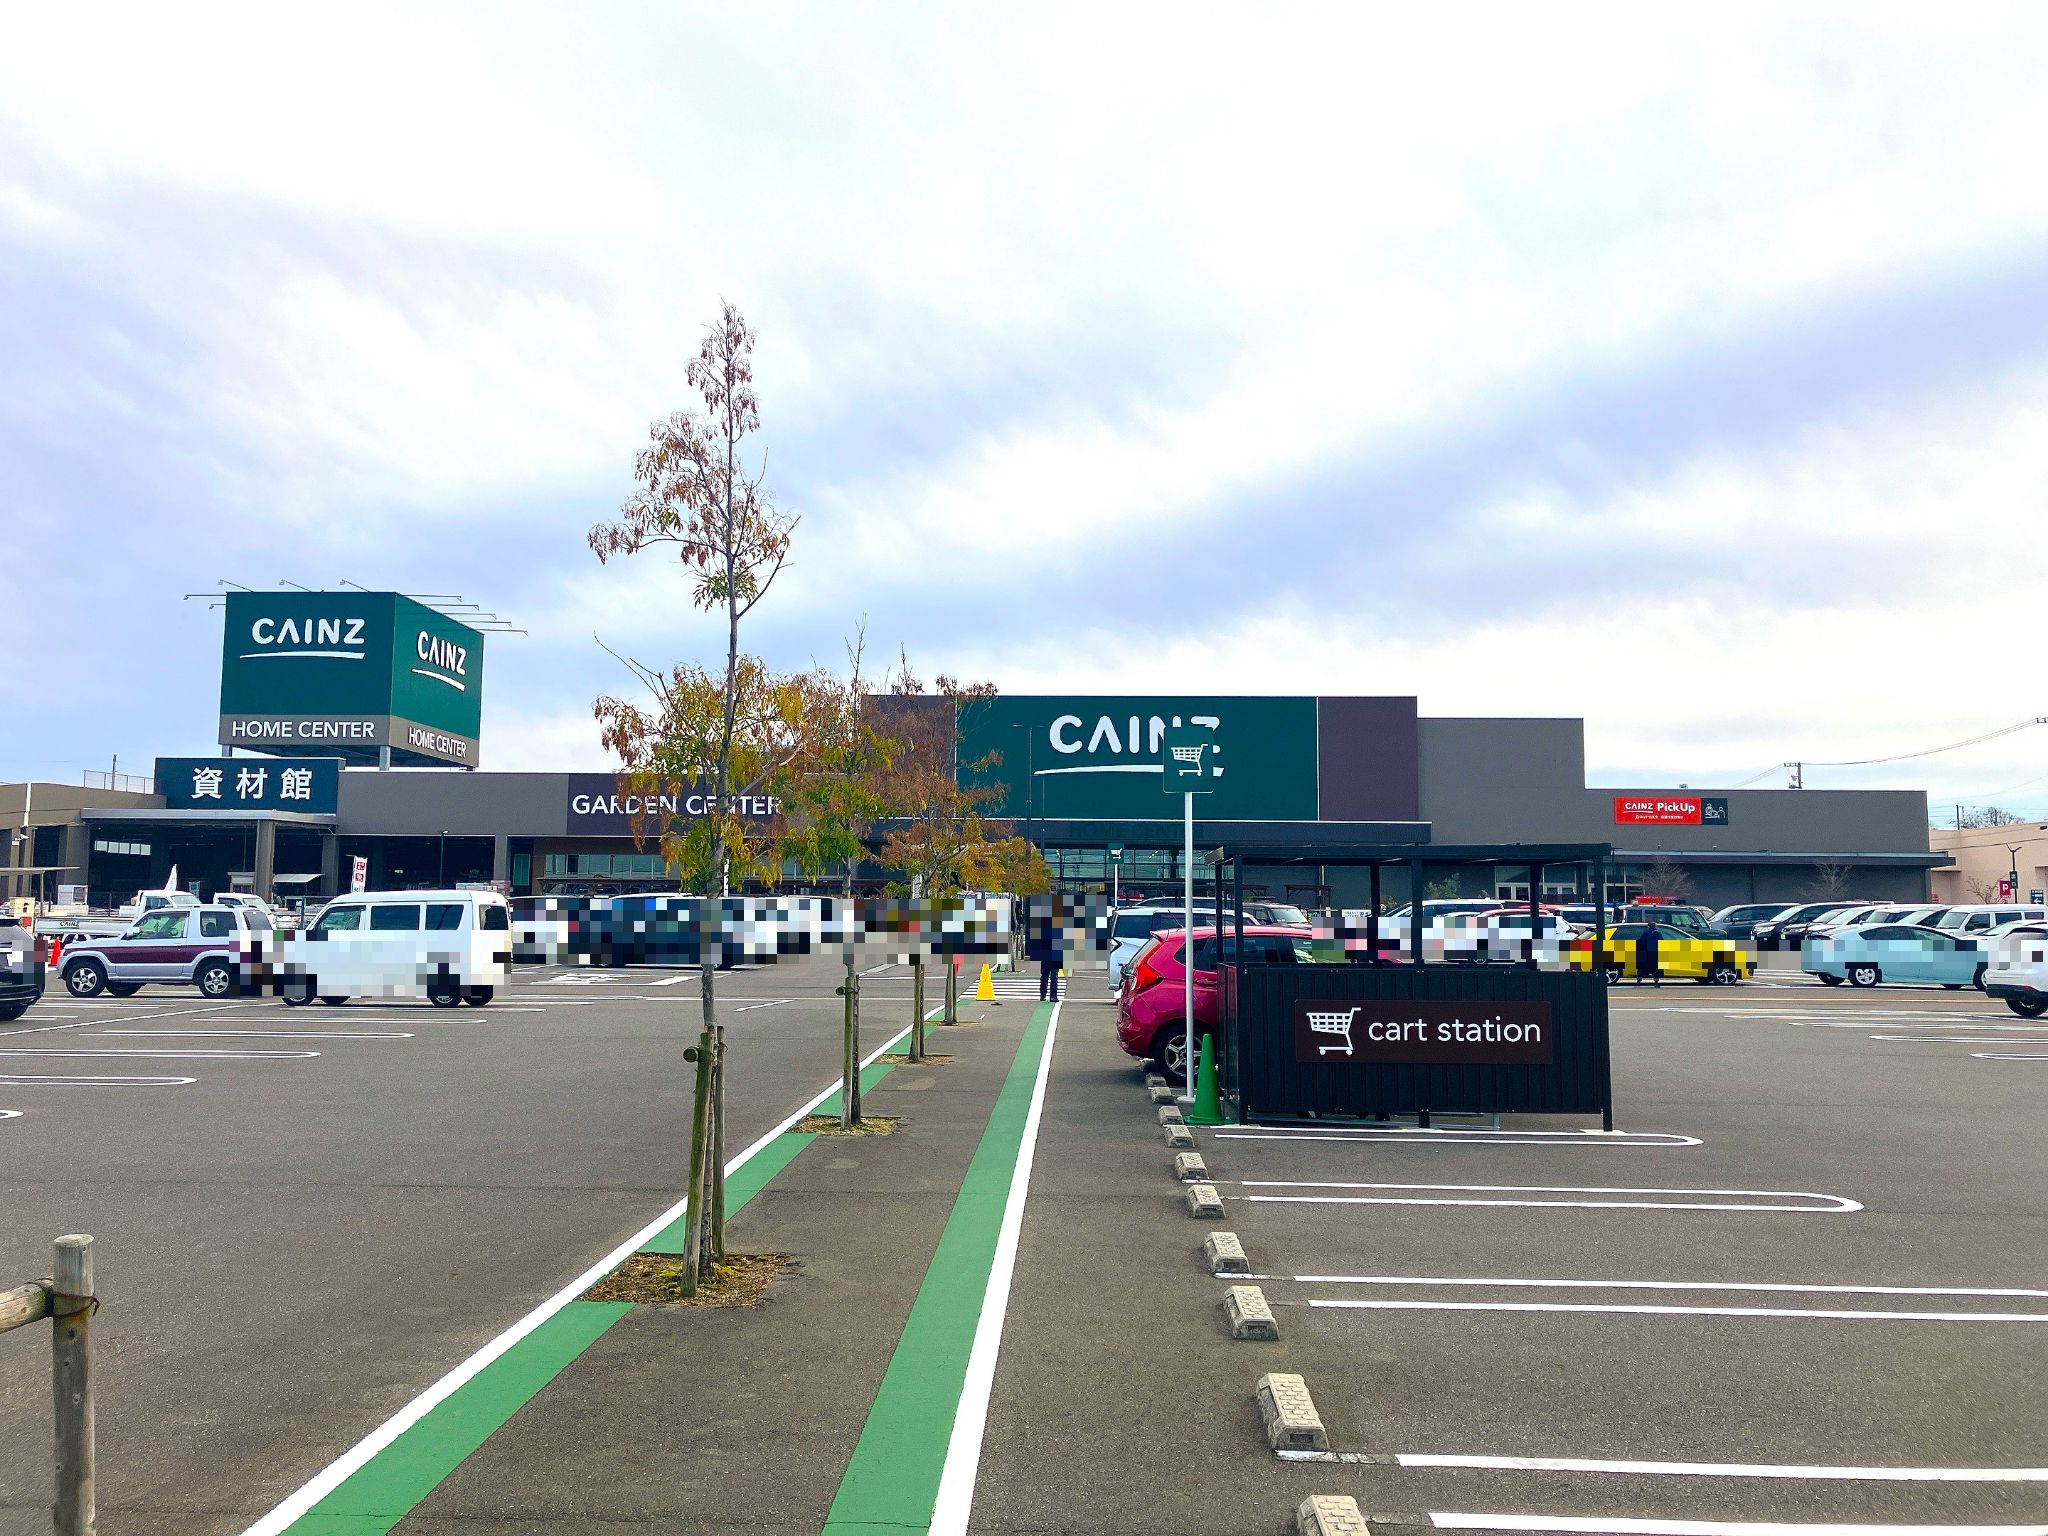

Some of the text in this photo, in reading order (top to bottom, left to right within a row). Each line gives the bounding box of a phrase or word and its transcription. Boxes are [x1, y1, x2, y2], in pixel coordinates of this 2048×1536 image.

[251, 617, 365, 645] CAINZ
[417, 631, 467, 676] CAINZ
[232, 720, 375, 738] HOME CENTER
[408, 726, 467, 758] HOME CENTER
[191, 766, 313, 800] 資材館
[1625, 802, 1653, 810] CAINZ
[1368, 1015, 1541, 1042] cart station
